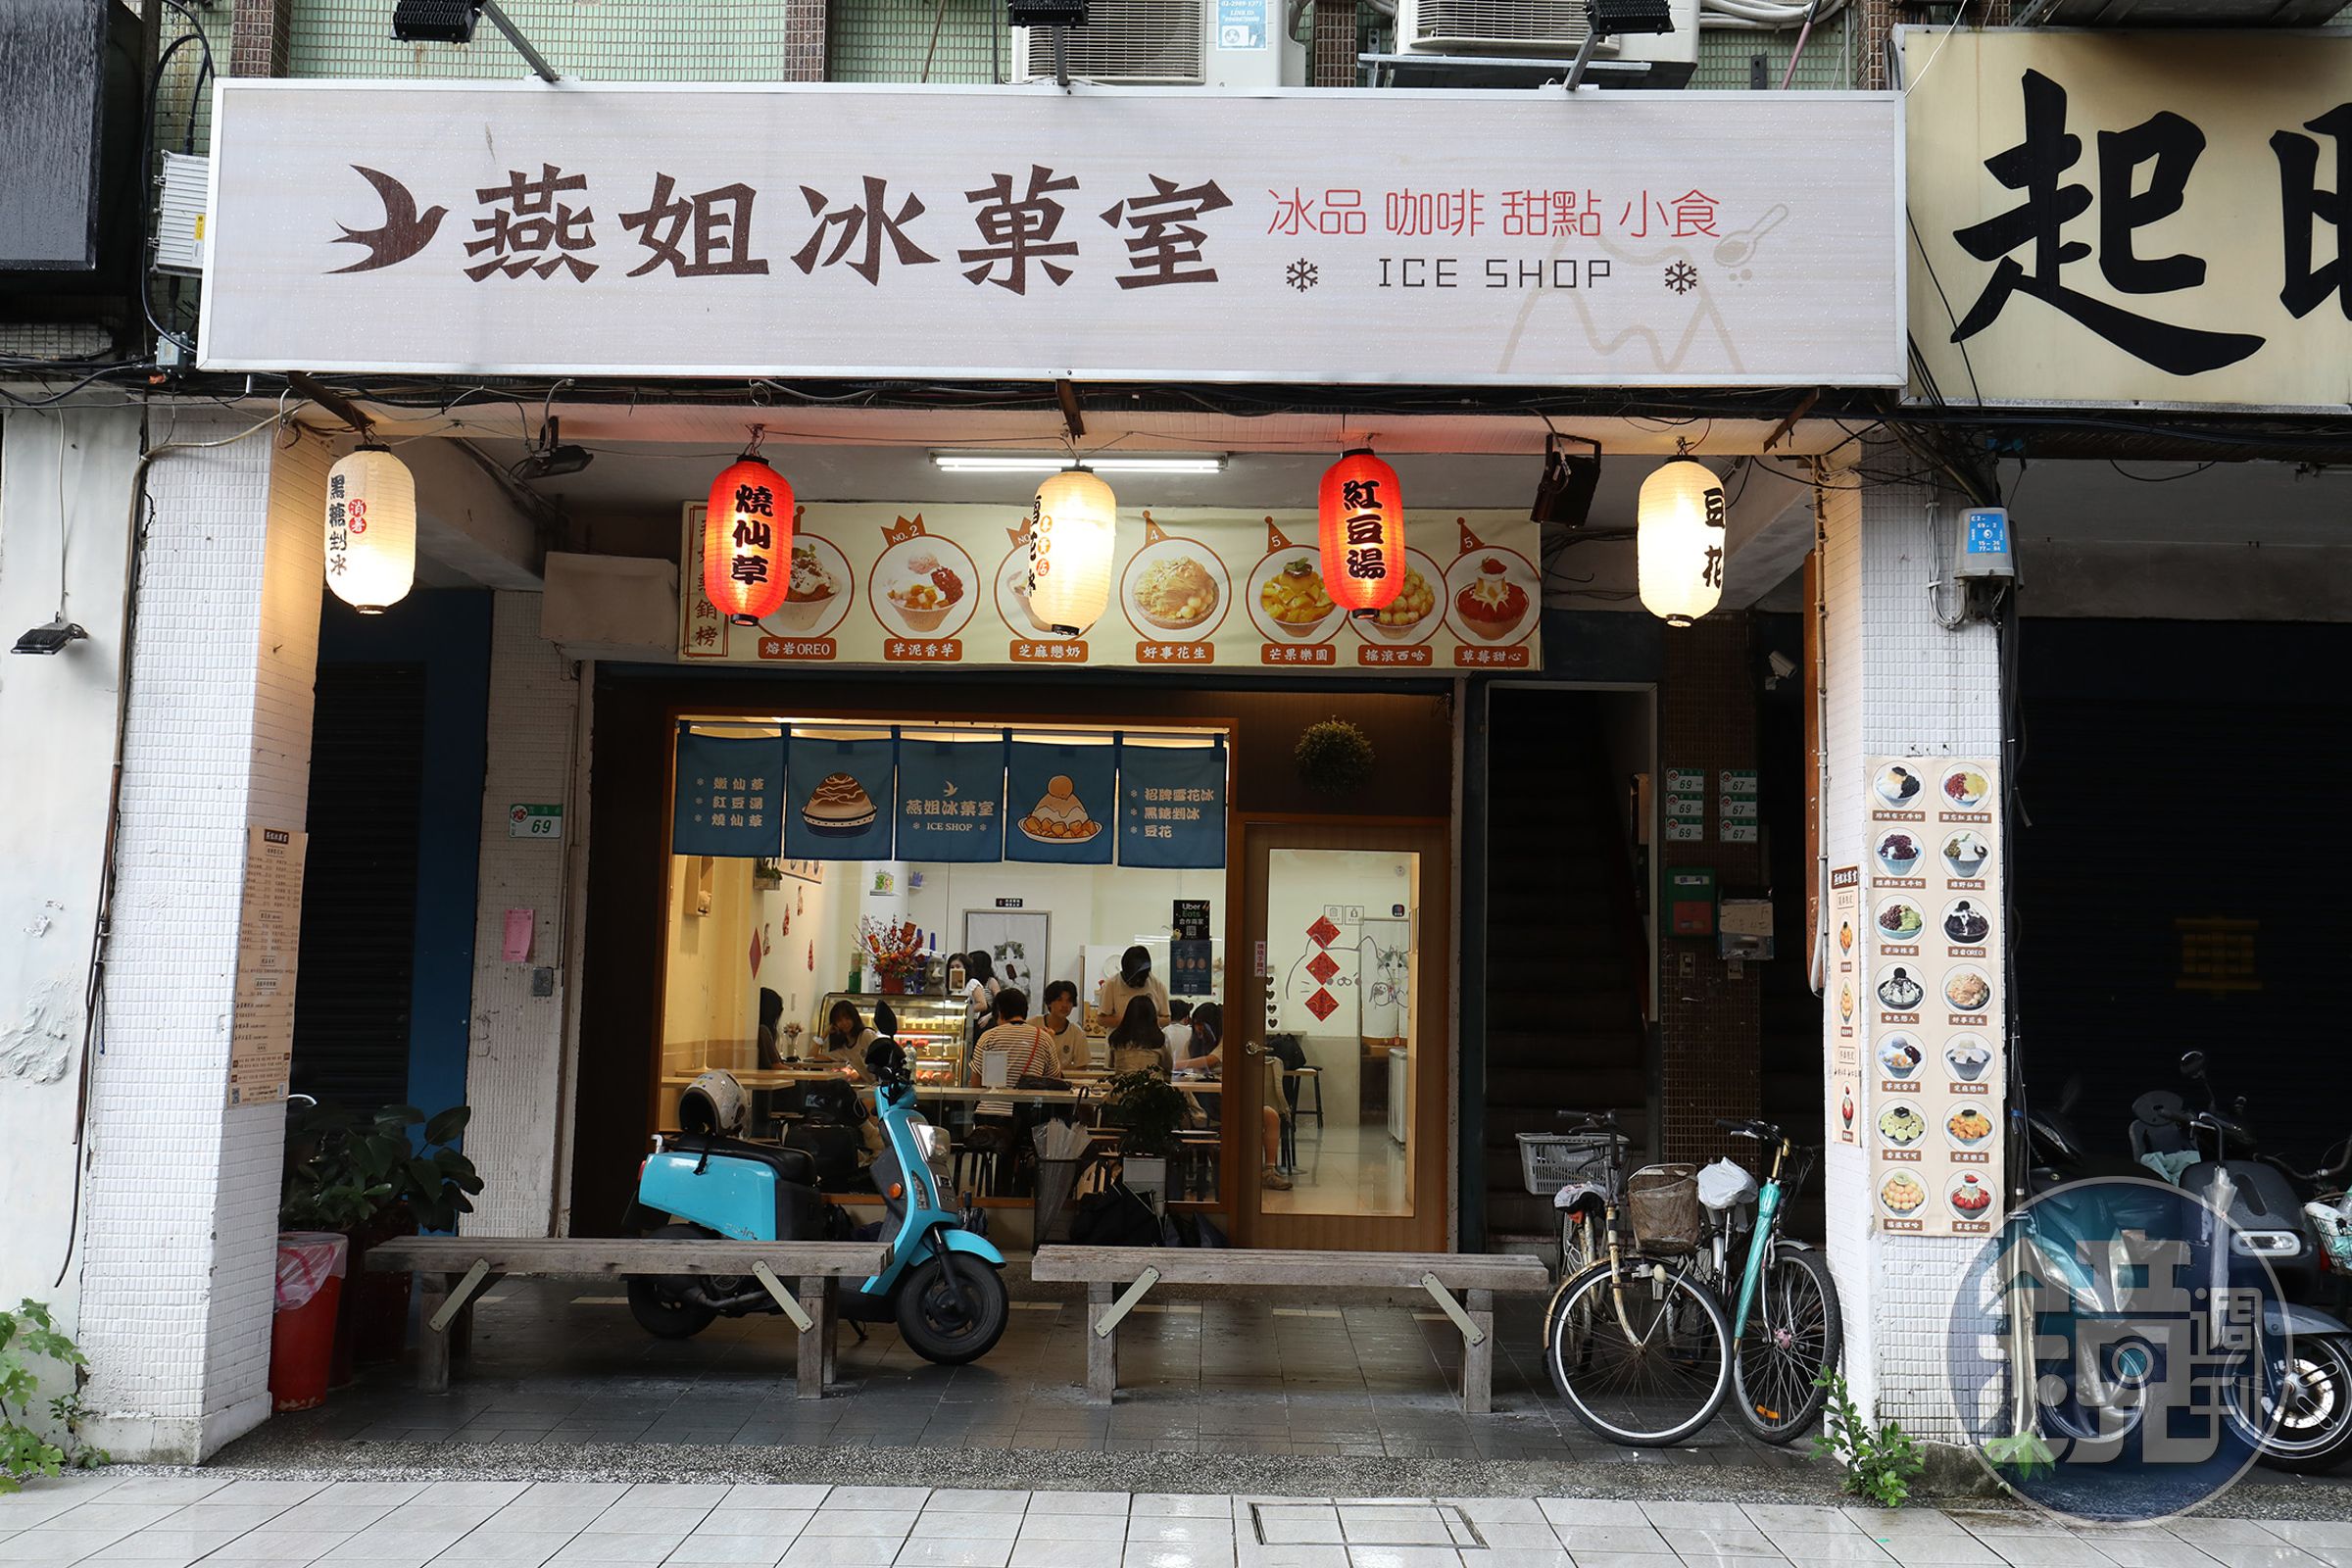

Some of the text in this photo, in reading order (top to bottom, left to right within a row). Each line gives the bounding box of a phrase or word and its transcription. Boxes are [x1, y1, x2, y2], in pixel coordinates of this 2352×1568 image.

[1267, 187, 1721, 238] 冰品 咖啡 甜點 小食
[464, 162, 1234, 297] 燕姐冰菓室
[1378, 258, 1611, 289] ICE SHOP
[730, 484, 774, 586] 燒仙草
[909, 524, 920, 537] 2
[1342, 479, 1387, 580] 紅豆湯
[1702, 487, 1726, 589] 豆花
[765, 643, 831, 657] 熔岩OREO
[892, 644, 955, 658] 芋泥香芋
[1143, 645, 1207, 660] 好事花生
[1679, 779, 1692, 790] 69
[1732, 781, 1745, 791] 67
[906, 799, 995, 816] 燕姐冰菓室
[1679, 804, 1692, 813] 69
[1732, 805, 1745, 815] 67
[531, 819, 552, 834] 69
[926, 821, 973, 832] ICE SHOP
[1144, 824, 1173, 839] 豆花
[1679, 828, 1691, 838] 69
[1733, 829, 1745, 839] 67
